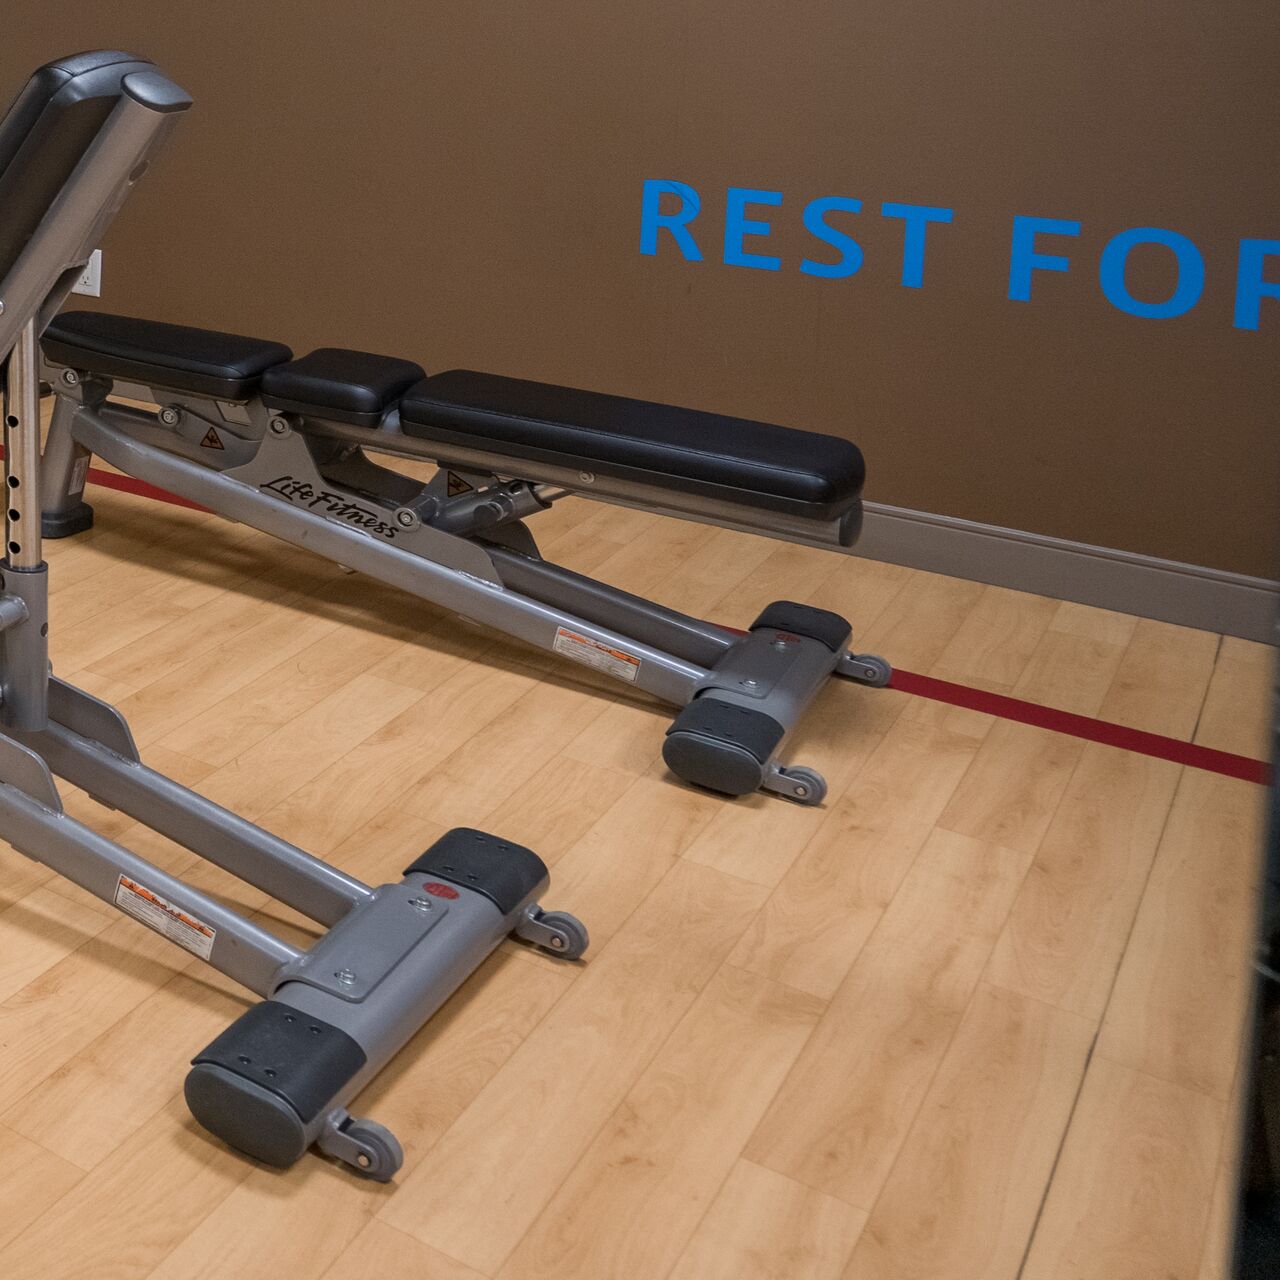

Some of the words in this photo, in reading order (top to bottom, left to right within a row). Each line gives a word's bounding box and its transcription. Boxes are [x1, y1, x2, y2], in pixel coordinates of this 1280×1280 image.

[639, 178, 955, 289] REST
[260, 475, 315, 502] Life
[308, 491, 400, 539] Fitness
